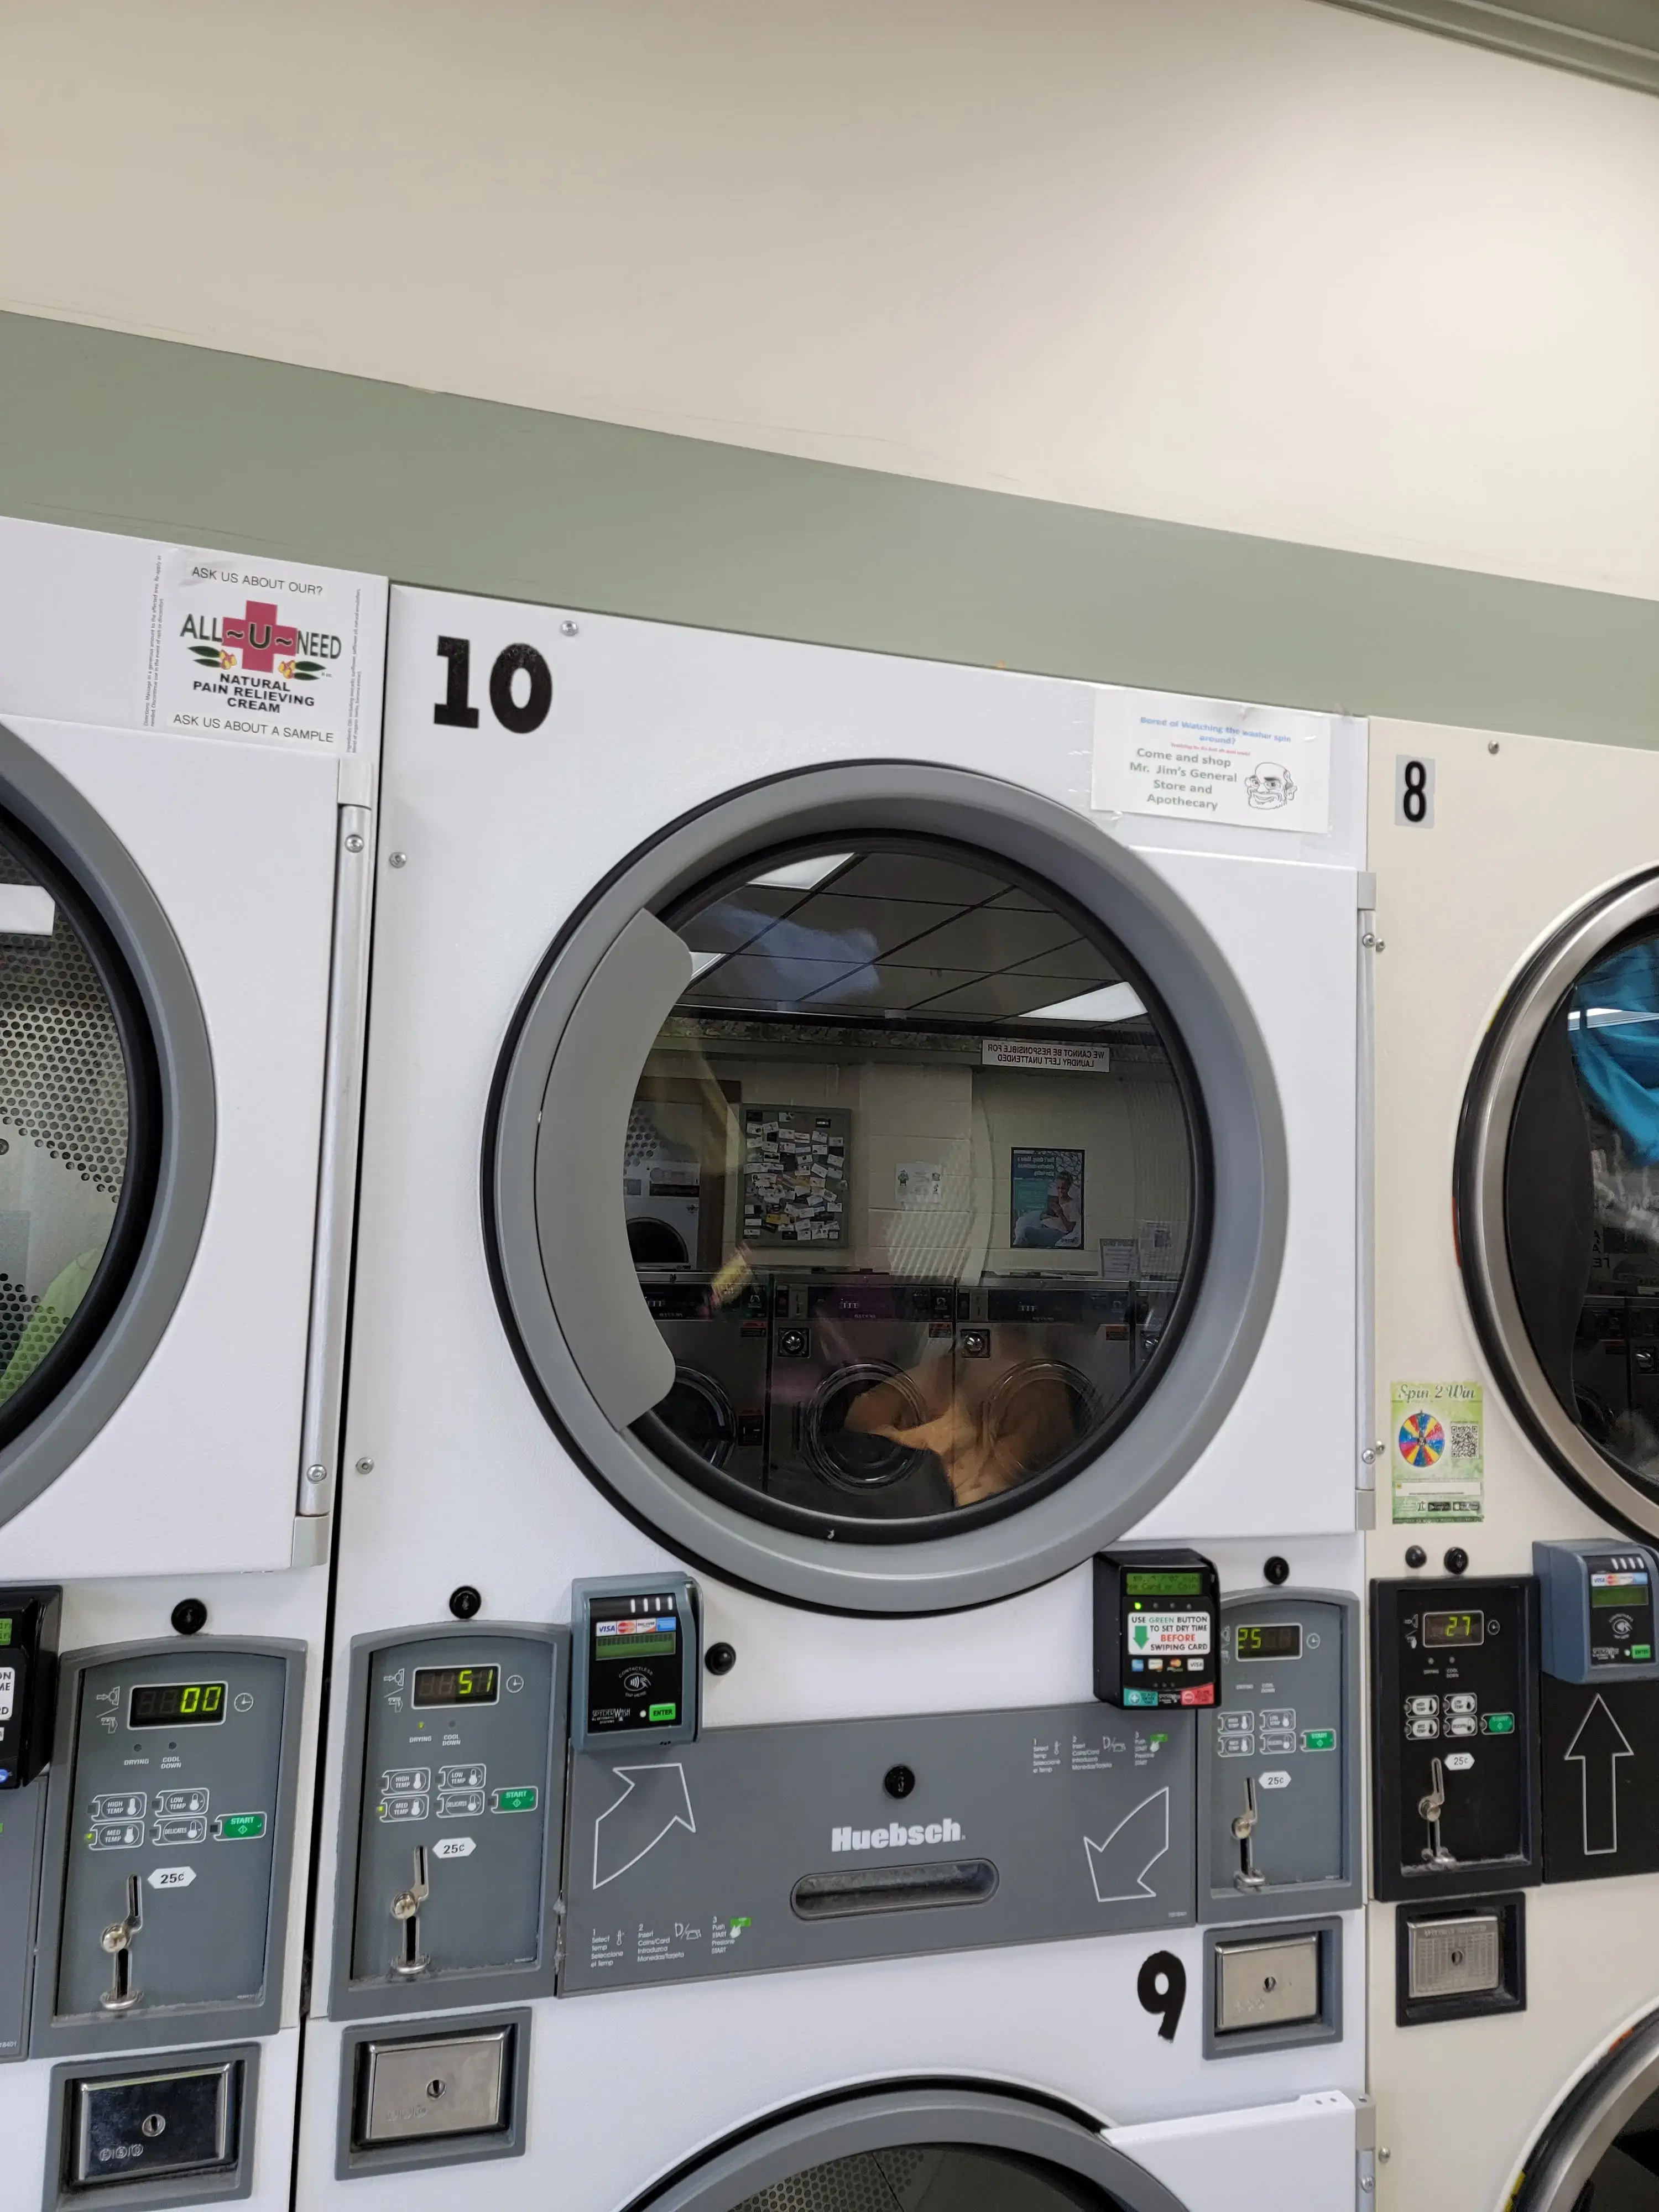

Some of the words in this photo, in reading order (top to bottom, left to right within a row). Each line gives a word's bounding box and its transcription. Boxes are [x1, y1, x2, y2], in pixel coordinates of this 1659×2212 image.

[192, 566, 217, 581] ASK
[221, 571, 239, 583] US
[242, 575, 285, 589] ABOUT
[289, 582, 323, 596] OUR?
[220, 673, 291, 692] NATURAL
[434, 635, 553, 734] 10
[192, 681, 228, 695] PAIN
[233, 686, 315, 707] RELIEVING
[227, 697, 280, 713] CREAM
[173, 714, 199, 726] ASK
[203, 717, 221, 728] US
[224, 720, 269, 734] ABOUT
[271, 726, 280, 736] A
[283, 727, 333, 742] SAMPLE
[1140, 717, 1167, 727] Bored
[1181, 721, 1224, 734] Watching
[1225, 726, 1240, 735] the
[1242, 729, 1272, 739] washer
[1274, 733, 1291, 743] spin
[1199, 734, 1237, 745] around?
[1136, 748, 1172, 760] Come
[1176, 754, 1199, 763] and
[1202, 756, 1232, 768] shop
[1130, 762, 1150, 773] Mr.
[1156, 765, 1186, 777] Jim's
[1190, 769, 1237, 782] General
[1154, 779, 1186, 791] Store
[1190, 785, 1213, 794] and
[1403, 760, 1427, 823] 8
[1147, 794, 1218, 811] Apothecary
[1398, 1384, 1431, 1404] Spin
[1434, 1385, 1444, 1399] 2
[1446, 1384, 1476, 1399] Win
[1446, 1615, 1471, 1637] 27
[1161, 1634, 1196, 1642] BEFORE
[505, 1791, 527, 1799] START
[231, 1817, 254, 1825] START
[832, 1818, 961, 1852] Huebsch
[442, 1844, 465, 1855] 25¢
[160, 1871, 185, 1885] 25¢
[592, 1928, 596, 1936] 1
[638, 1923, 644, 1931] 2
[638, 1930, 654, 1939] Insert
[712, 1931, 727, 1939] START
[591, 1950, 624, 1960] Seleccione
[1136, 1950, 1186, 2042] 9
